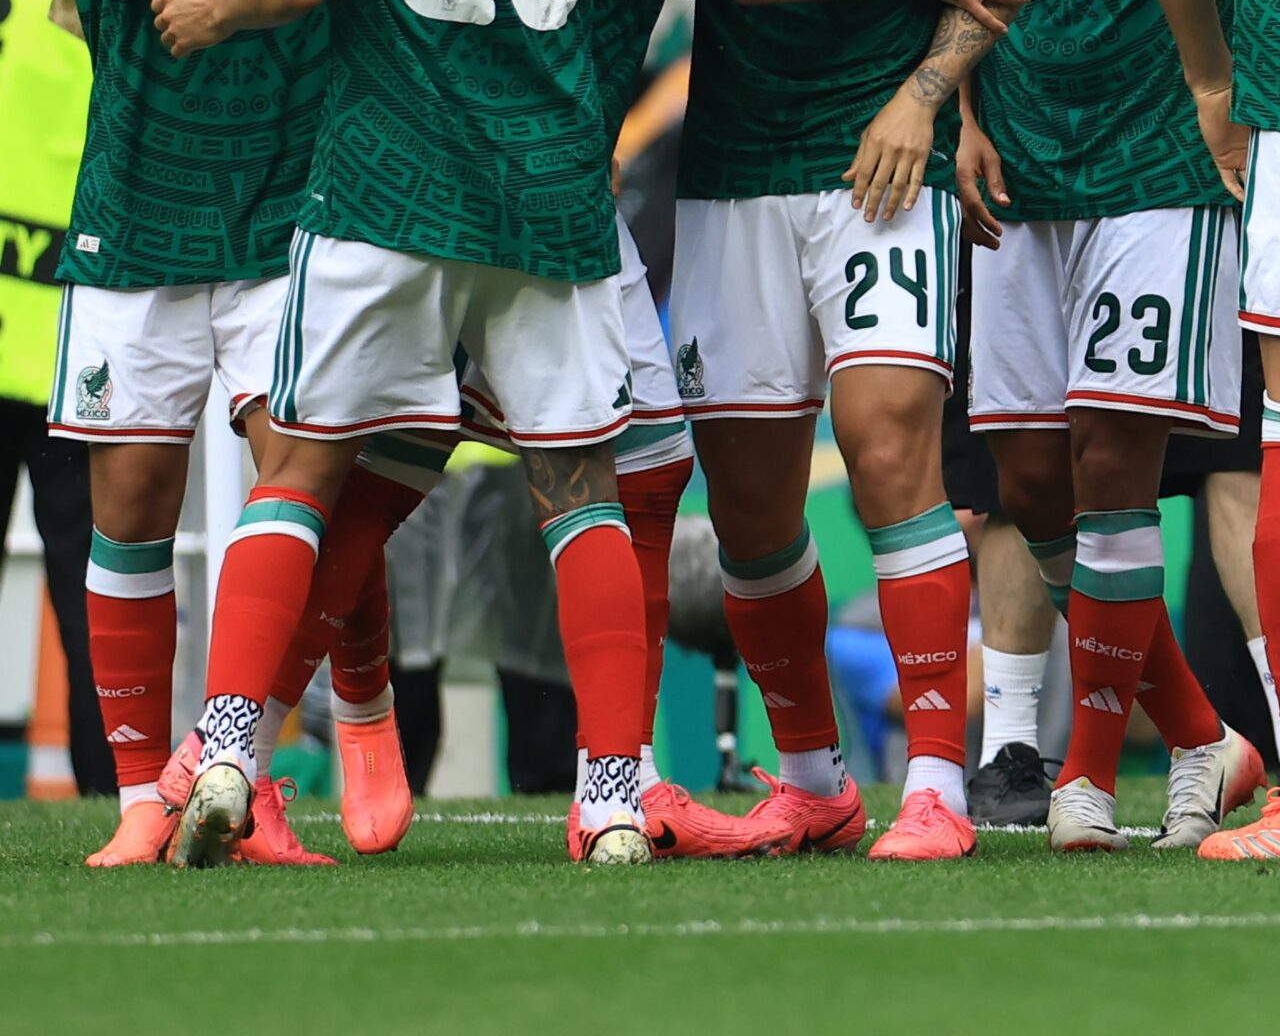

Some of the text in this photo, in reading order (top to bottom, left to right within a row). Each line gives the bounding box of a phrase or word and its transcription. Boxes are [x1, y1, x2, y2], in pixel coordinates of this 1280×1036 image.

[845, 247, 928, 331] 24
[1084, 291, 1171, 376] 23
[1075, 636, 1143, 661] MÉXICO
